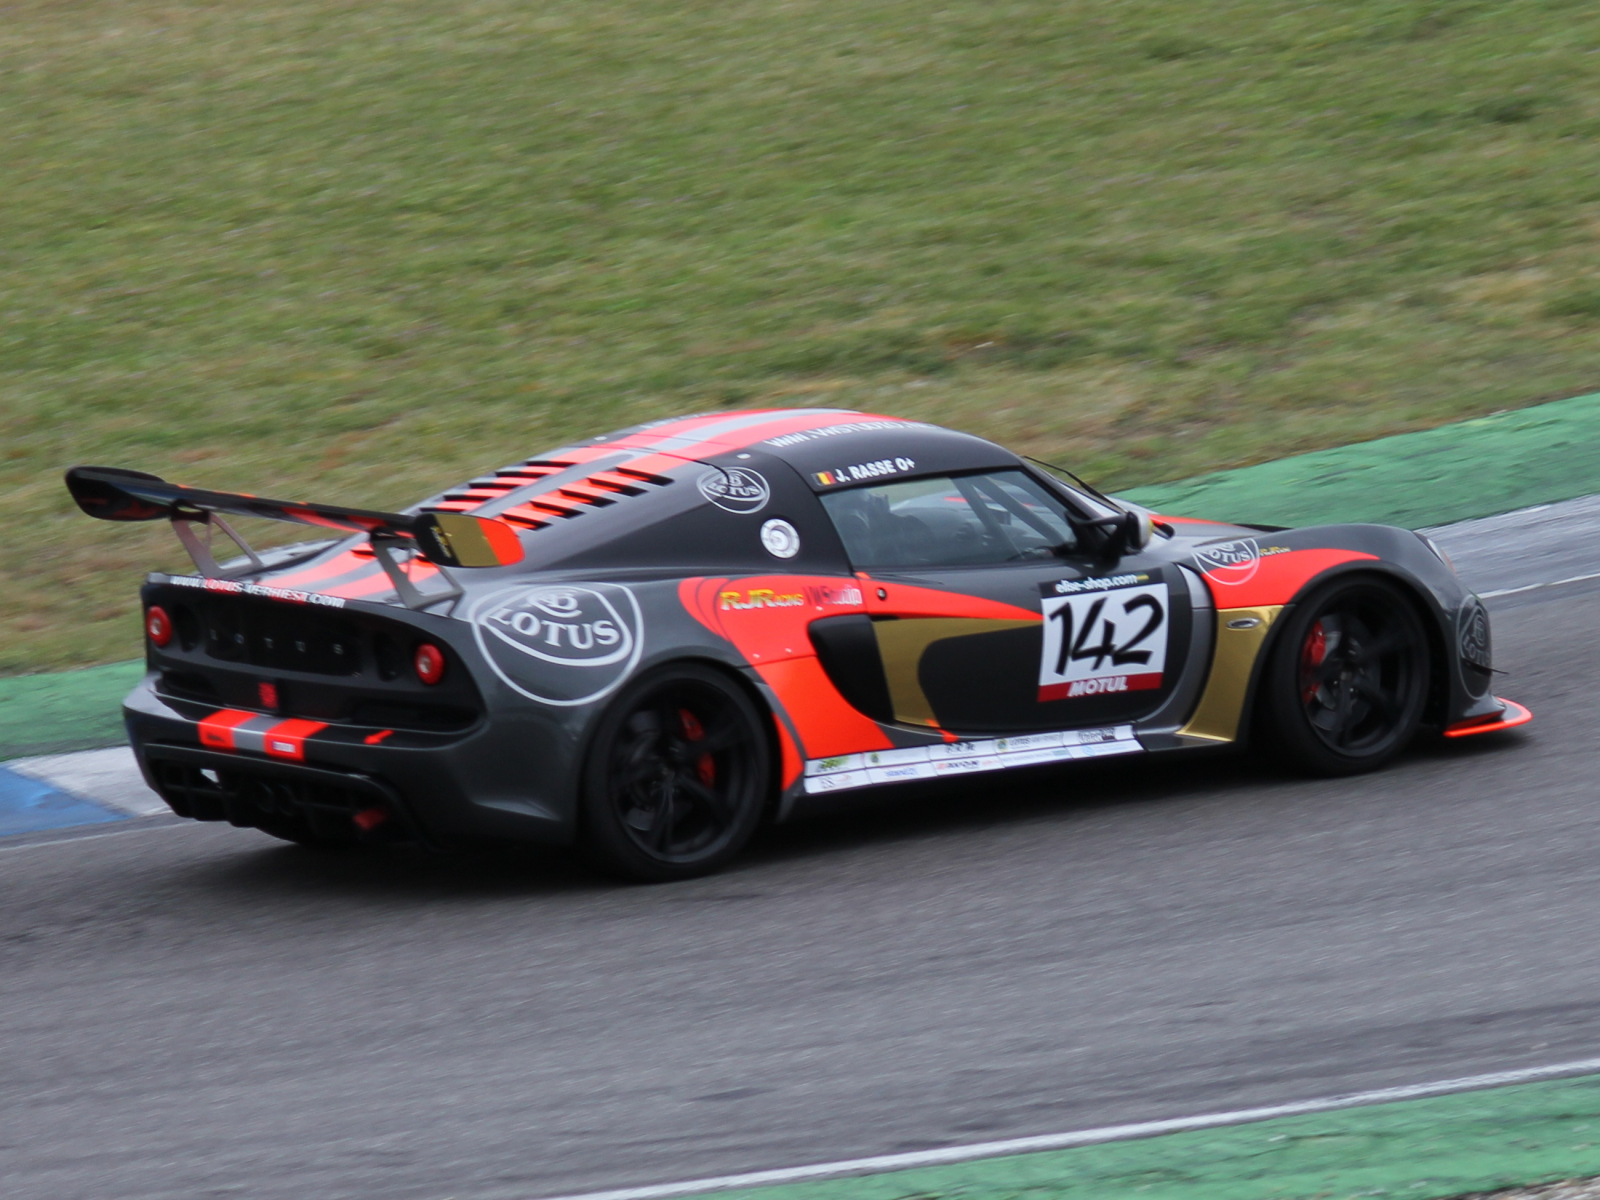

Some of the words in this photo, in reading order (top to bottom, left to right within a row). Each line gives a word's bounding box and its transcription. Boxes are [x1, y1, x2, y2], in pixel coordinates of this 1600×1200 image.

[836, 469, 851, 483] J.
[847, 459, 897, 480] RASSE
[707, 482, 760, 497] LOTUS
[1055, 574, 1138, 593] elise-shop.com
[488, 608, 620, 650] LOTUS
[1048, 593, 1165, 676] 142
[1067, 676, 1128, 697] MOTUL
